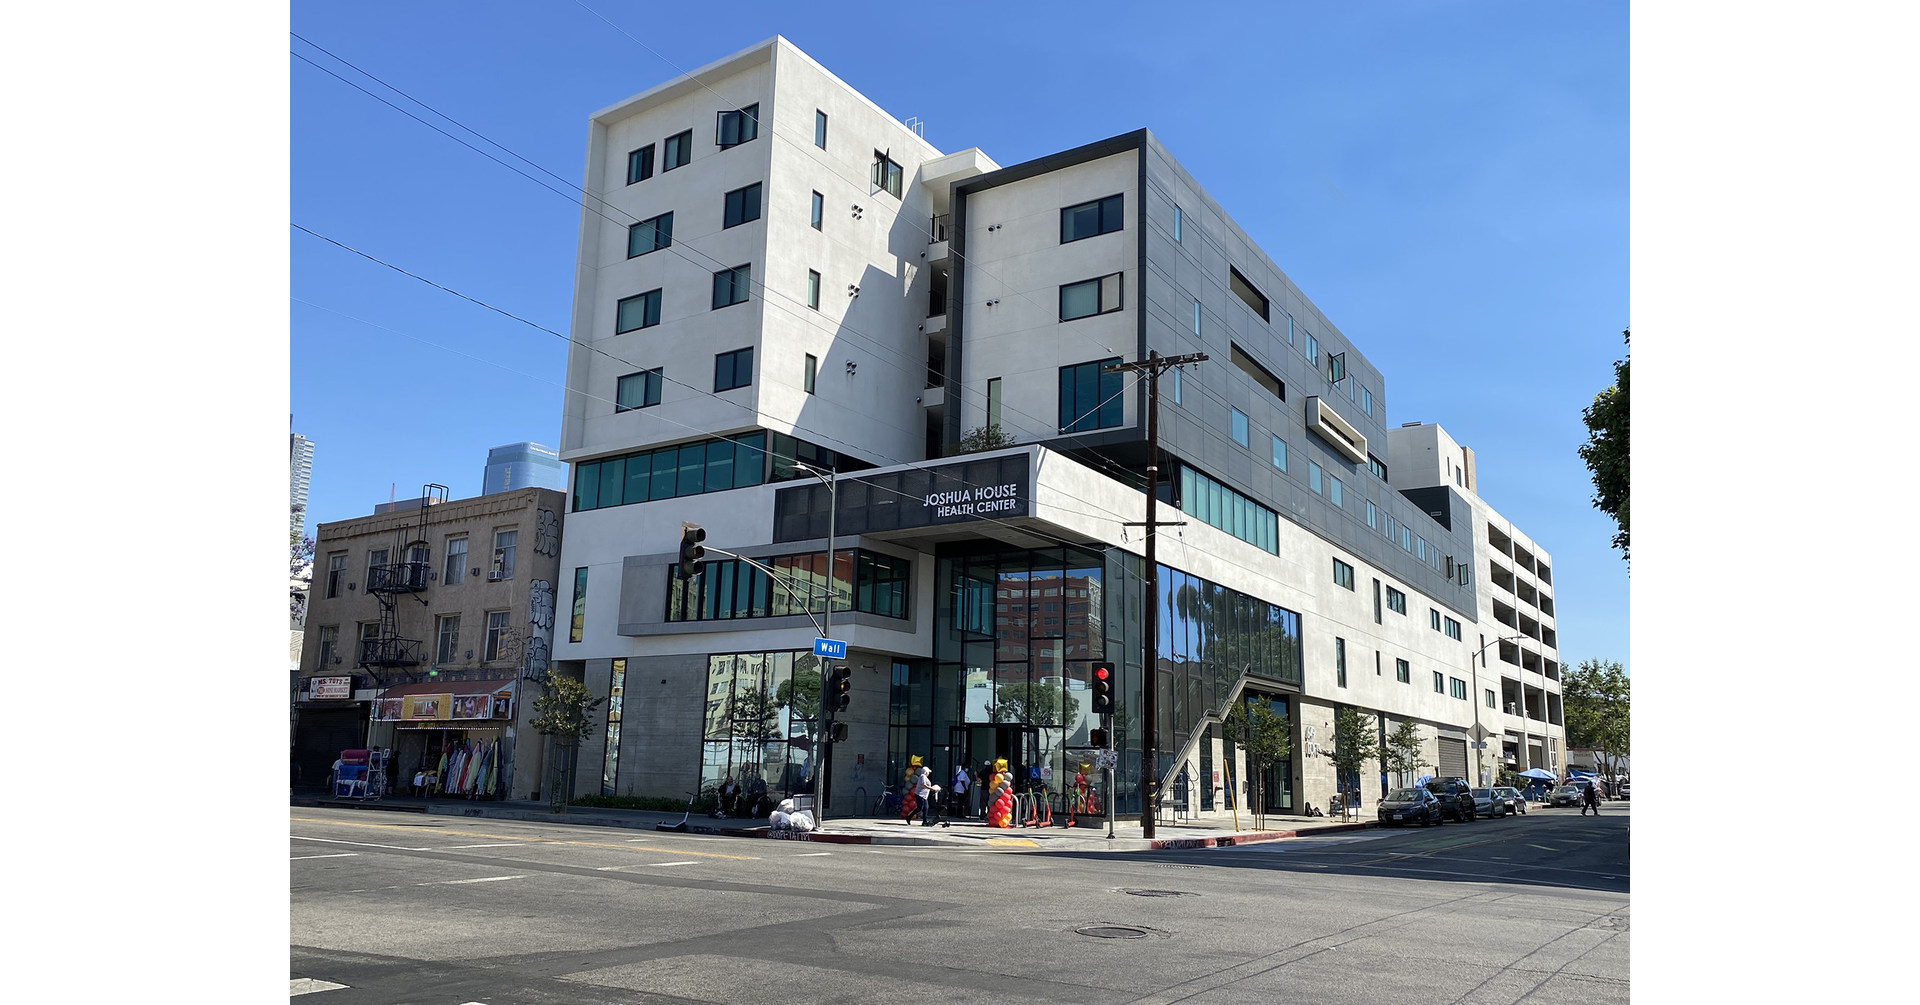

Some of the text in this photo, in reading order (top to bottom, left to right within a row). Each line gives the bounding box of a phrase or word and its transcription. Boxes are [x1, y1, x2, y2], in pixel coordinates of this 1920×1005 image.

[923, 483, 1017, 506] JOSHUA HOUSE
[937, 498, 1016, 518] HEALTH CENTER
[821, 642, 840, 654] Wall
